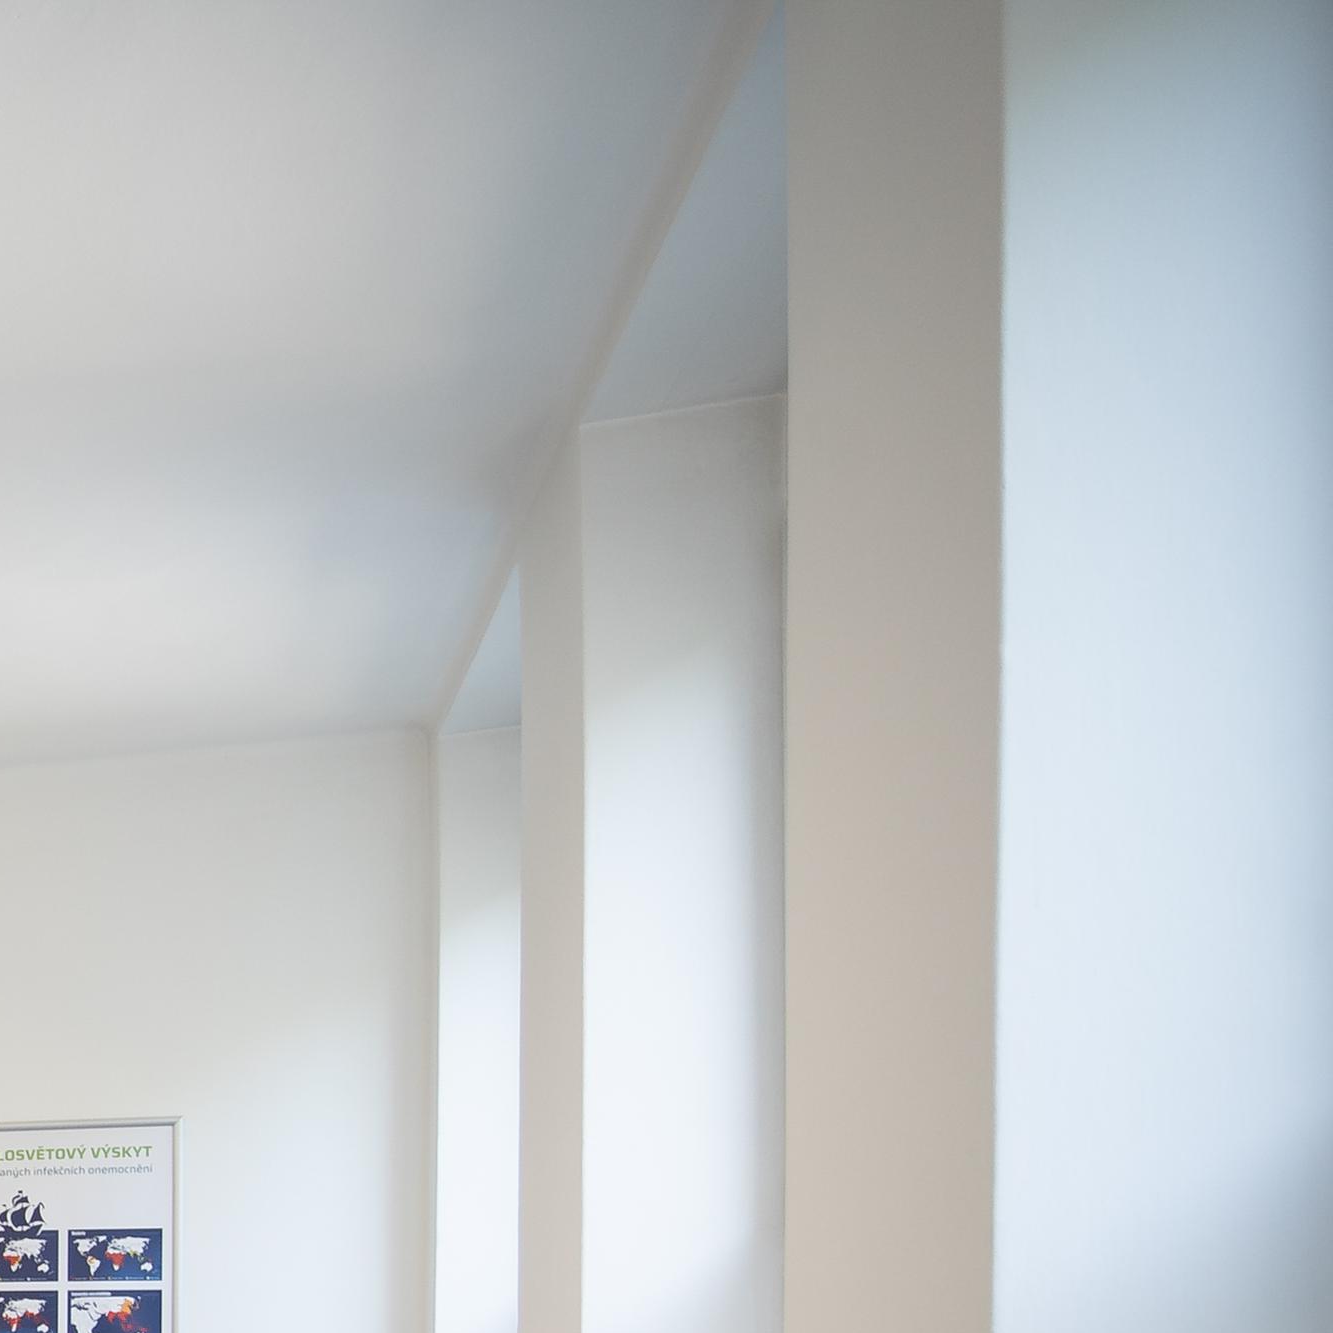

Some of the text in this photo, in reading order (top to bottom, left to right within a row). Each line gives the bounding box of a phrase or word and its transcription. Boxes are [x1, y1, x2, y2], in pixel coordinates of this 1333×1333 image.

[91, 1144, 153, 1159] VÝSKYT
[33, 1165, 85, 1177] infekčních
[88, 1163, 153, 1175] onemocnění
